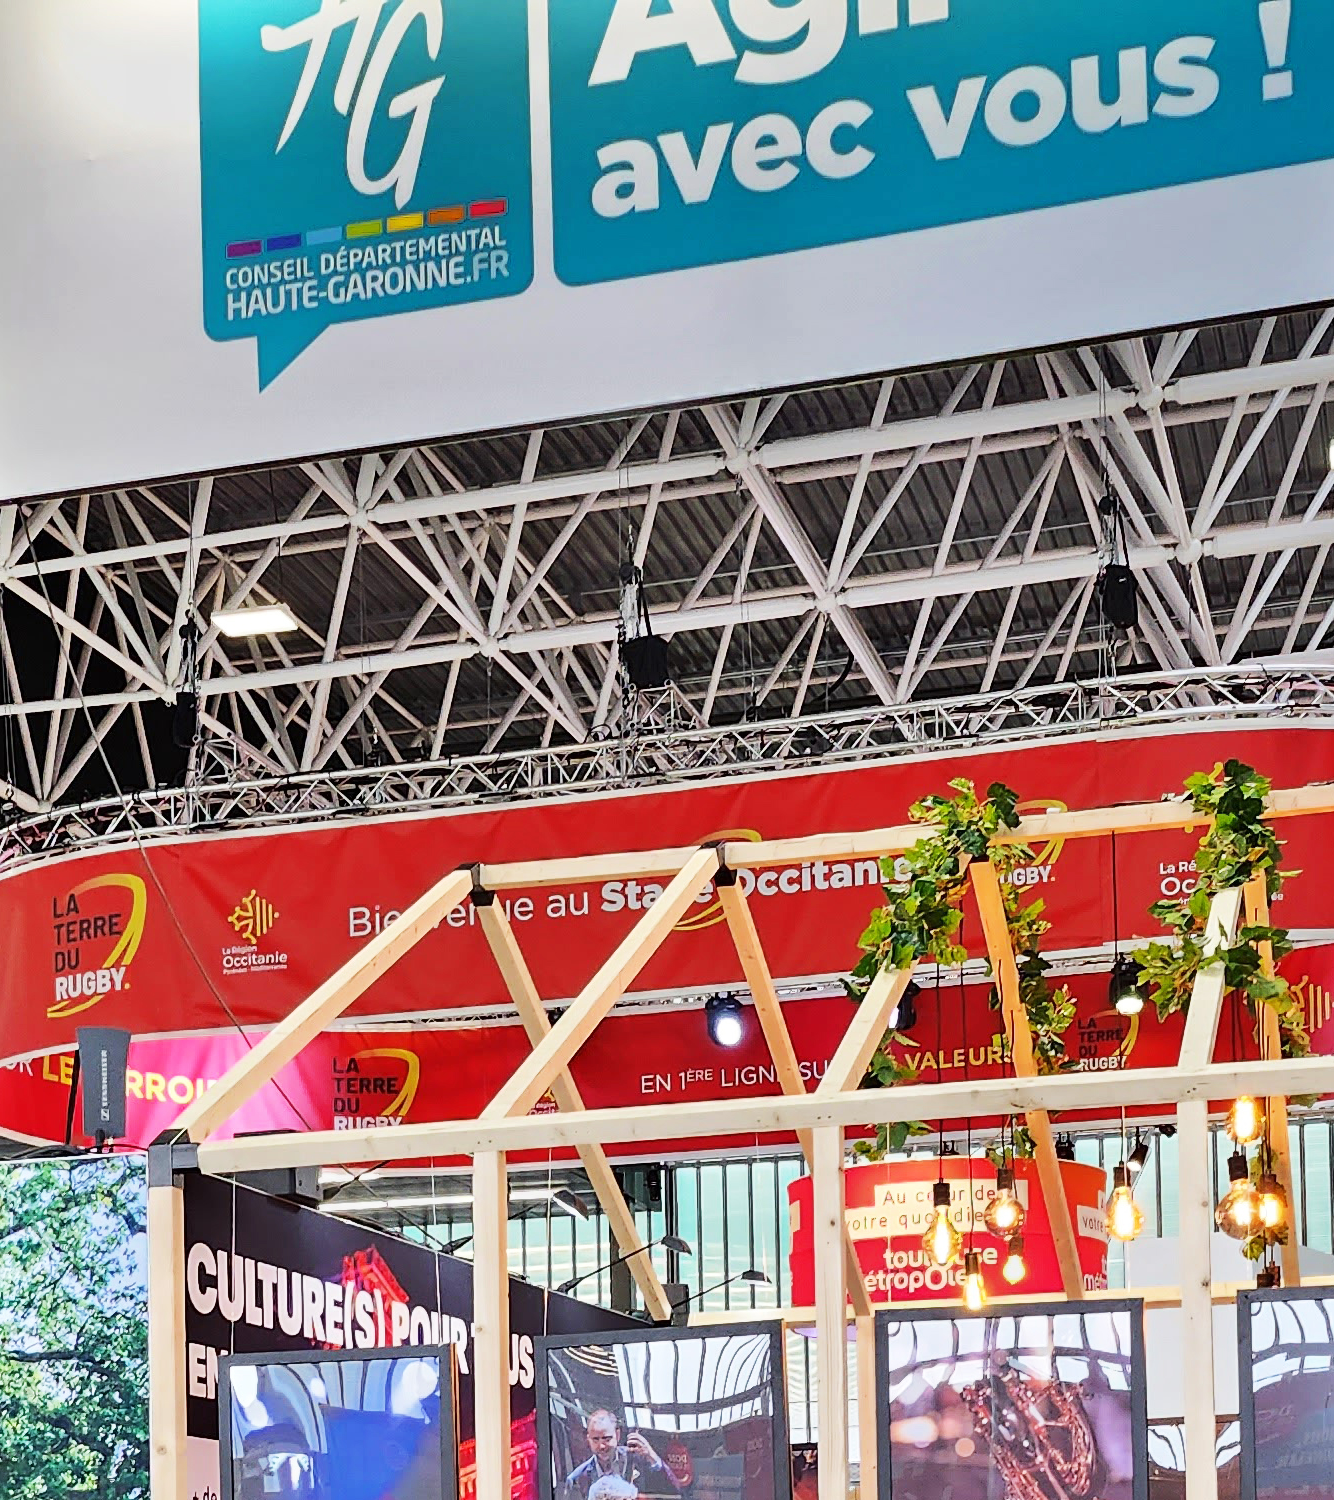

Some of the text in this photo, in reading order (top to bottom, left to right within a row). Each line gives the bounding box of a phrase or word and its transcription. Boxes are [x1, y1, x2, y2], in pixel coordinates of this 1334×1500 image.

[591, 99, 875, 218] avec
[906, 36, 1220, 160] vous
[225, 225, 507, 290] CONSEIL DÉPARTEMENTAL
[226, 250, 510, 321] HAUTE-GARONNE.FR
[1159, 862, 1177, 875] La
[53, 893, 79, 918] LA
[546, 891, 589, 917] au
[600, 880, 715, 911] Stae
[54, 913, 123, 943] TERRE
[54, 947, 80, 973] DU
[222, 950, 288, 968] Occitanie
[1078, 1018, 1097, 1030] LA
[1079, 1027, 1124, 1043] TERRE
[1079, 1045, 1097, 1057] DU
[332, 1056, 360, 1074] LA
[332, 1076, 399, 1095] TERRE
[641, 1074, 671, 1094] EN
[679, 1067, 713, 1090] 1ÈRE
[721, 1065, 781, 1087] LIGN
[799, 1060, 830, 1081] SU
[333, 1098, 360, 1114] DU
[883, 1190, 905, 1205] Au
[974, 1184, 996, 1201] de
[187, 1242, 386, 1350] CULTURE(S)
